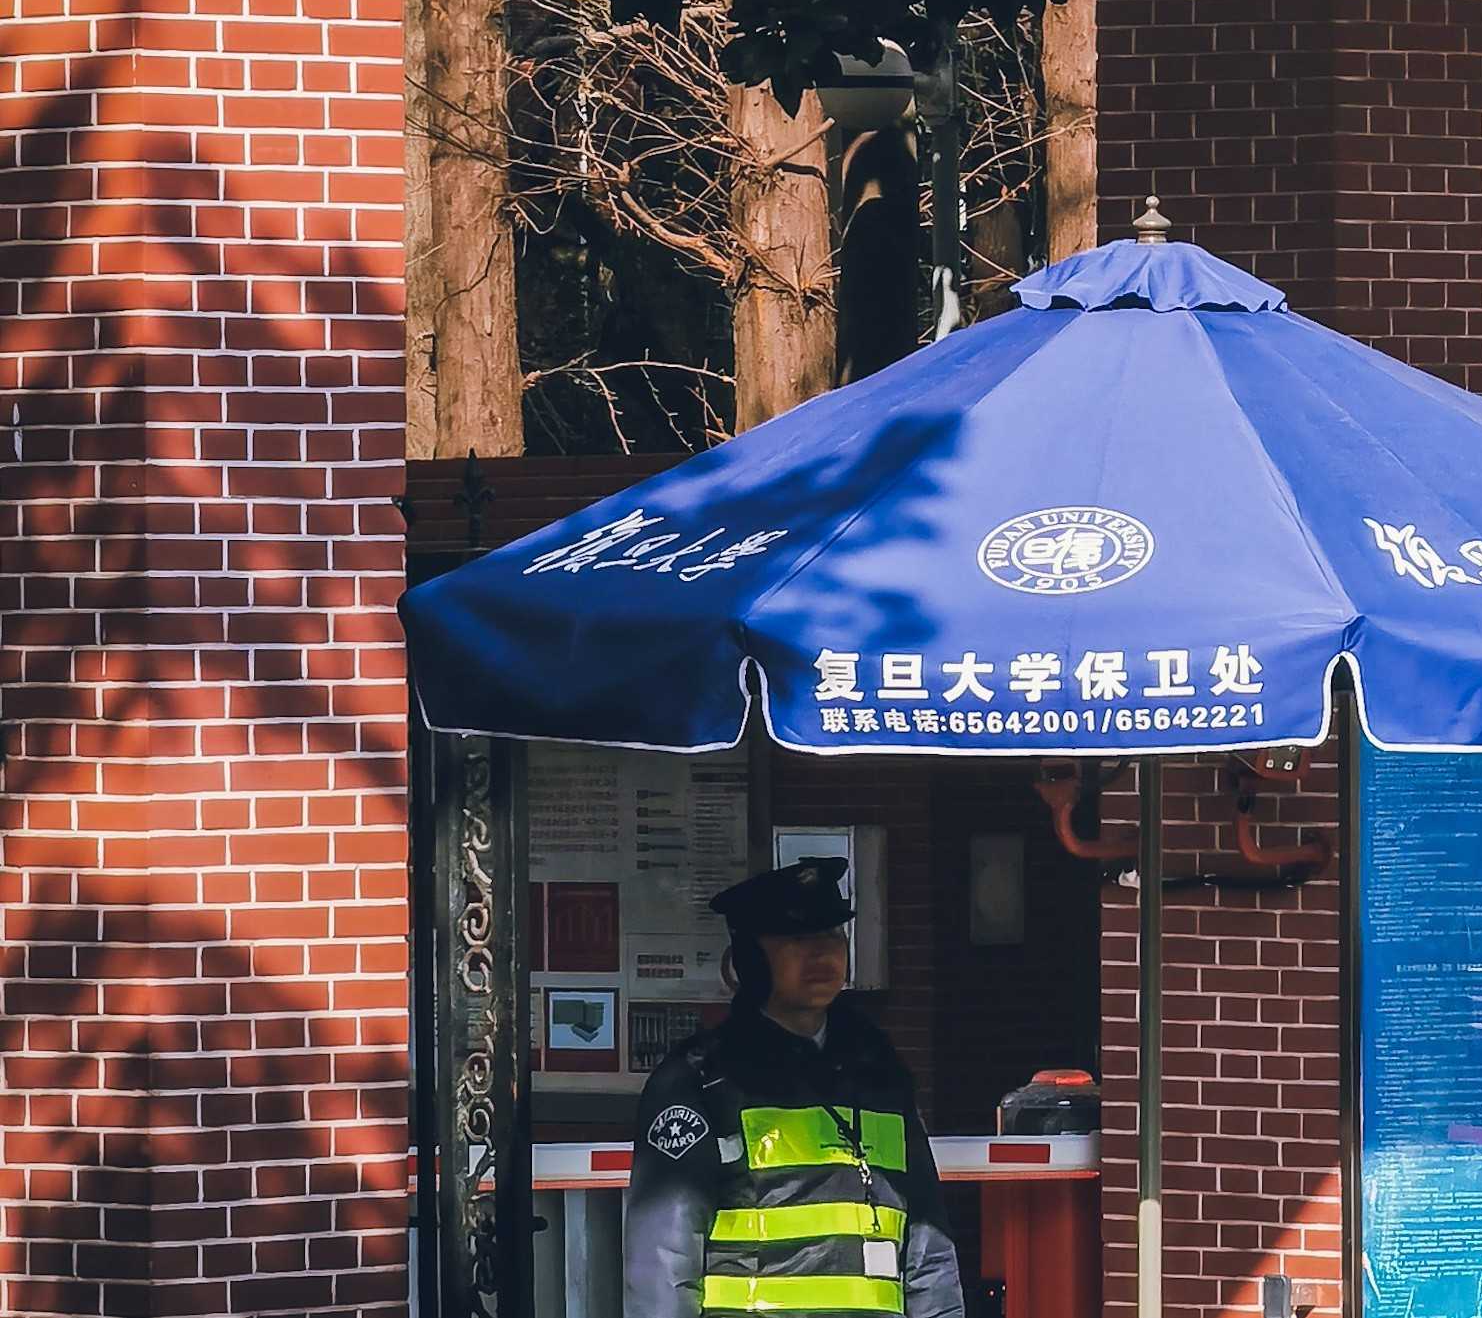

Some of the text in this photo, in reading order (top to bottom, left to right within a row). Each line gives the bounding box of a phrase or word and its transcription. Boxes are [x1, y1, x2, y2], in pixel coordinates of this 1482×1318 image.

[986, 511, 1146, 570] FUDAN UNIVERSITY
[1012, 572, 1104, 591] 1905
[813, 644, 1264, 703] 复旦大学保卫处
